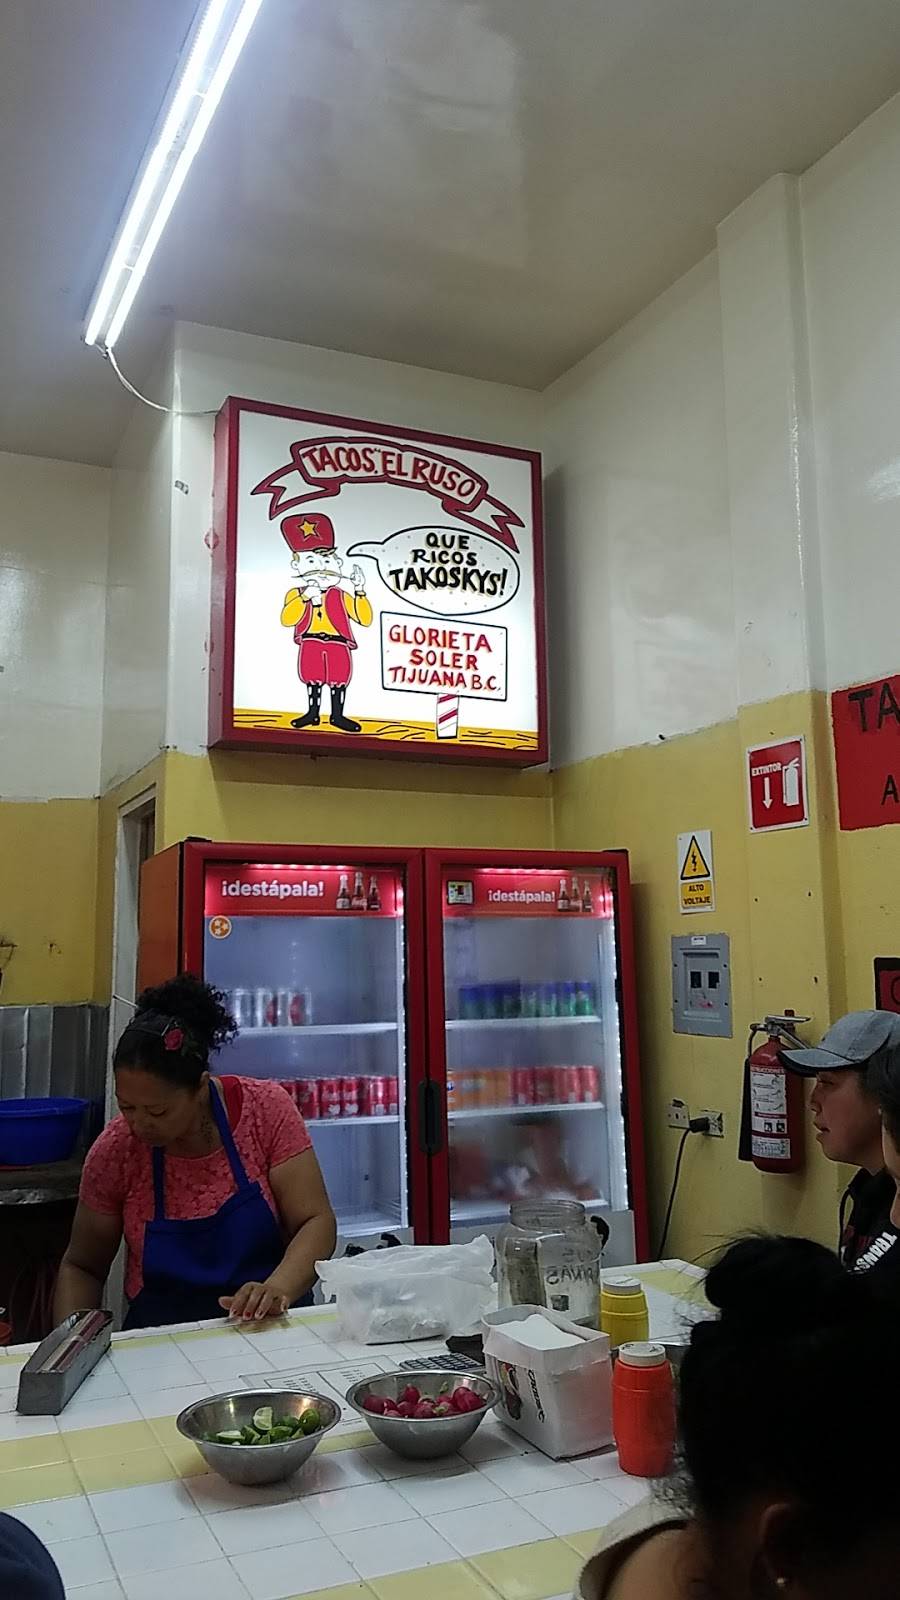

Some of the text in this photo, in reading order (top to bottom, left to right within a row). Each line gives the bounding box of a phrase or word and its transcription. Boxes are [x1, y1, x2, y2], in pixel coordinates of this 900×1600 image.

[426, 532, 470, 550] QUE
[411, 549, 477, 566] RICOS
[389, 566, 508, 596] TAKOSKYS!
[389, 624, 493, 653] GLORIETA
[409, 649, 479, 671] SOLER
[388, 666, 467, 688] TIJUANA
[751, 762, 782, 776] EXTINTOR
[221, 880, 324, 900] ¡destápala!
[488, 890, 556, 904] ¡destápala!
[688, 884, 705, 892] ALTO
[684, 896, 711, 905] VOLTAJE
